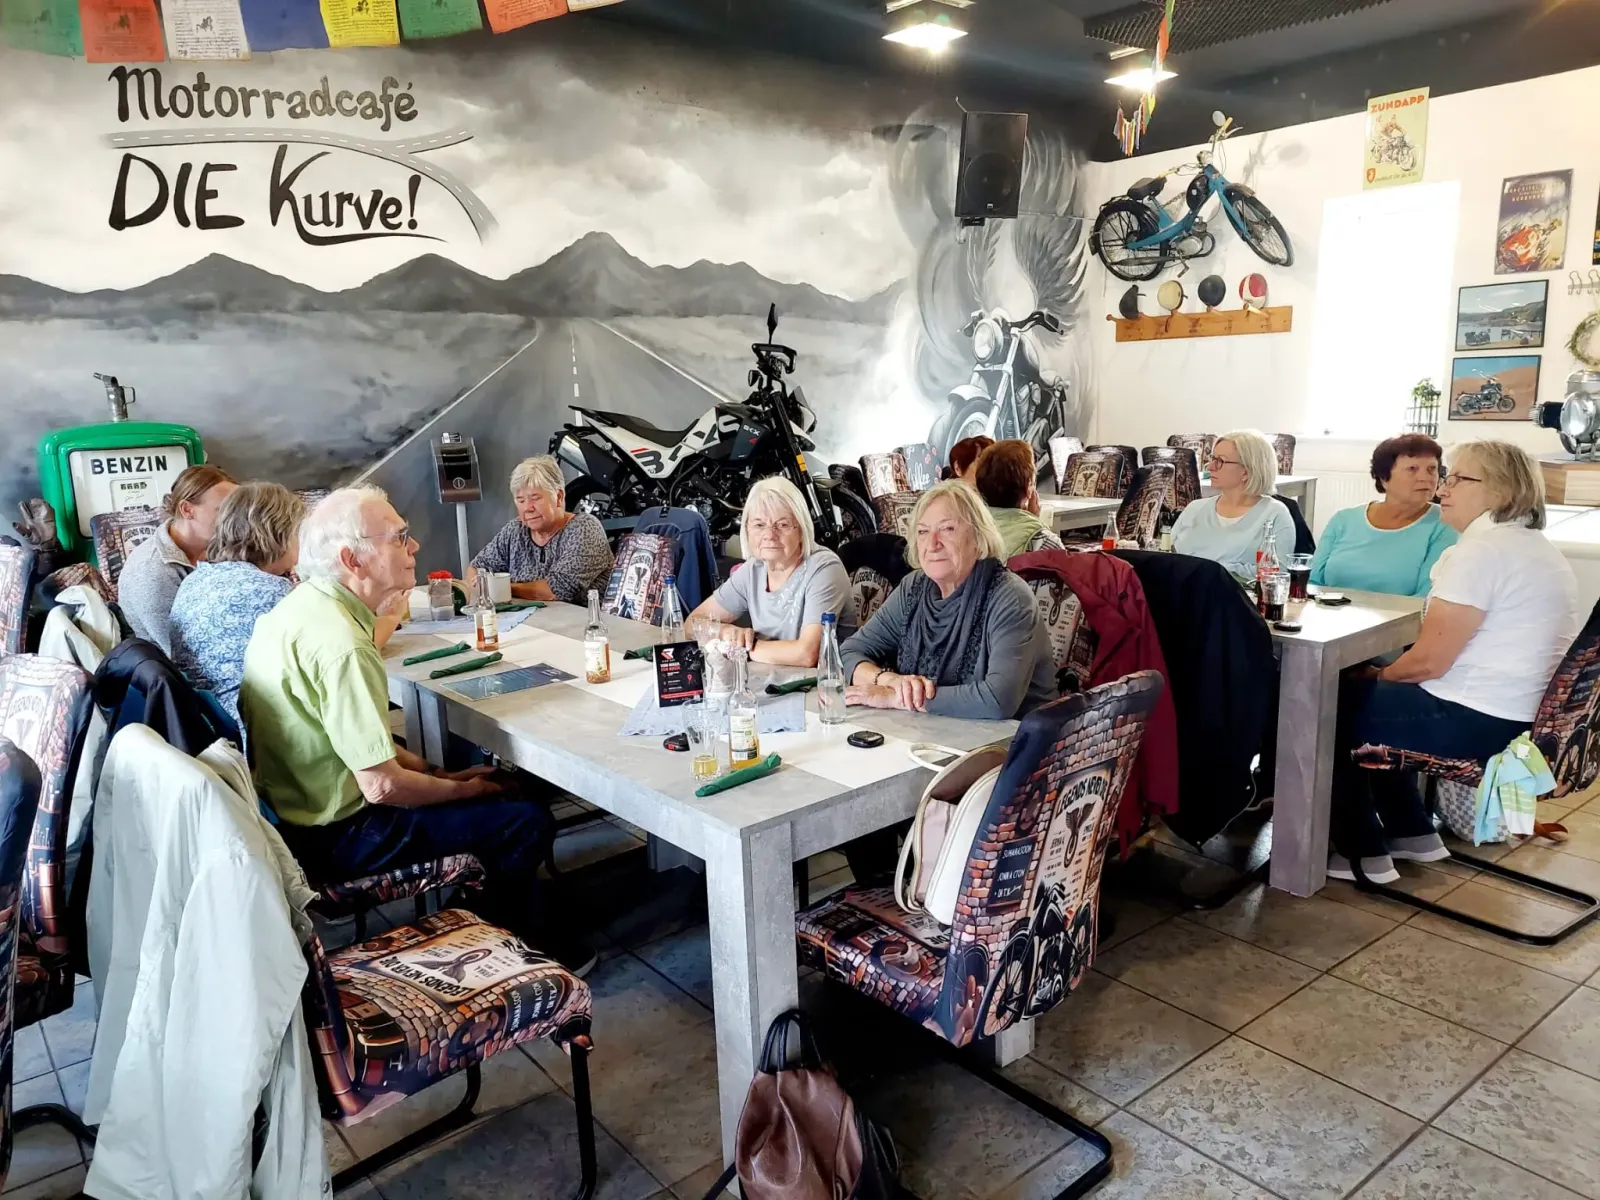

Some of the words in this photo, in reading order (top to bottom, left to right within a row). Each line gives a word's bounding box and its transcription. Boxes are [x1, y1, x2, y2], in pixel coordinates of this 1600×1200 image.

[108, 65, 418, 131] Motorradcafé
[108, 152, 245, 231] DIE
[269, 144, 446, 246] Kurve!
[91, 455, 168, 475] BENZIN
[1056, 778, 1087, 818] LEGENDS
[379, 956, 401, 968] DIE
[391, 963, 427, 980] NEVER
[418, 976, 476, 998] LEGENDS
